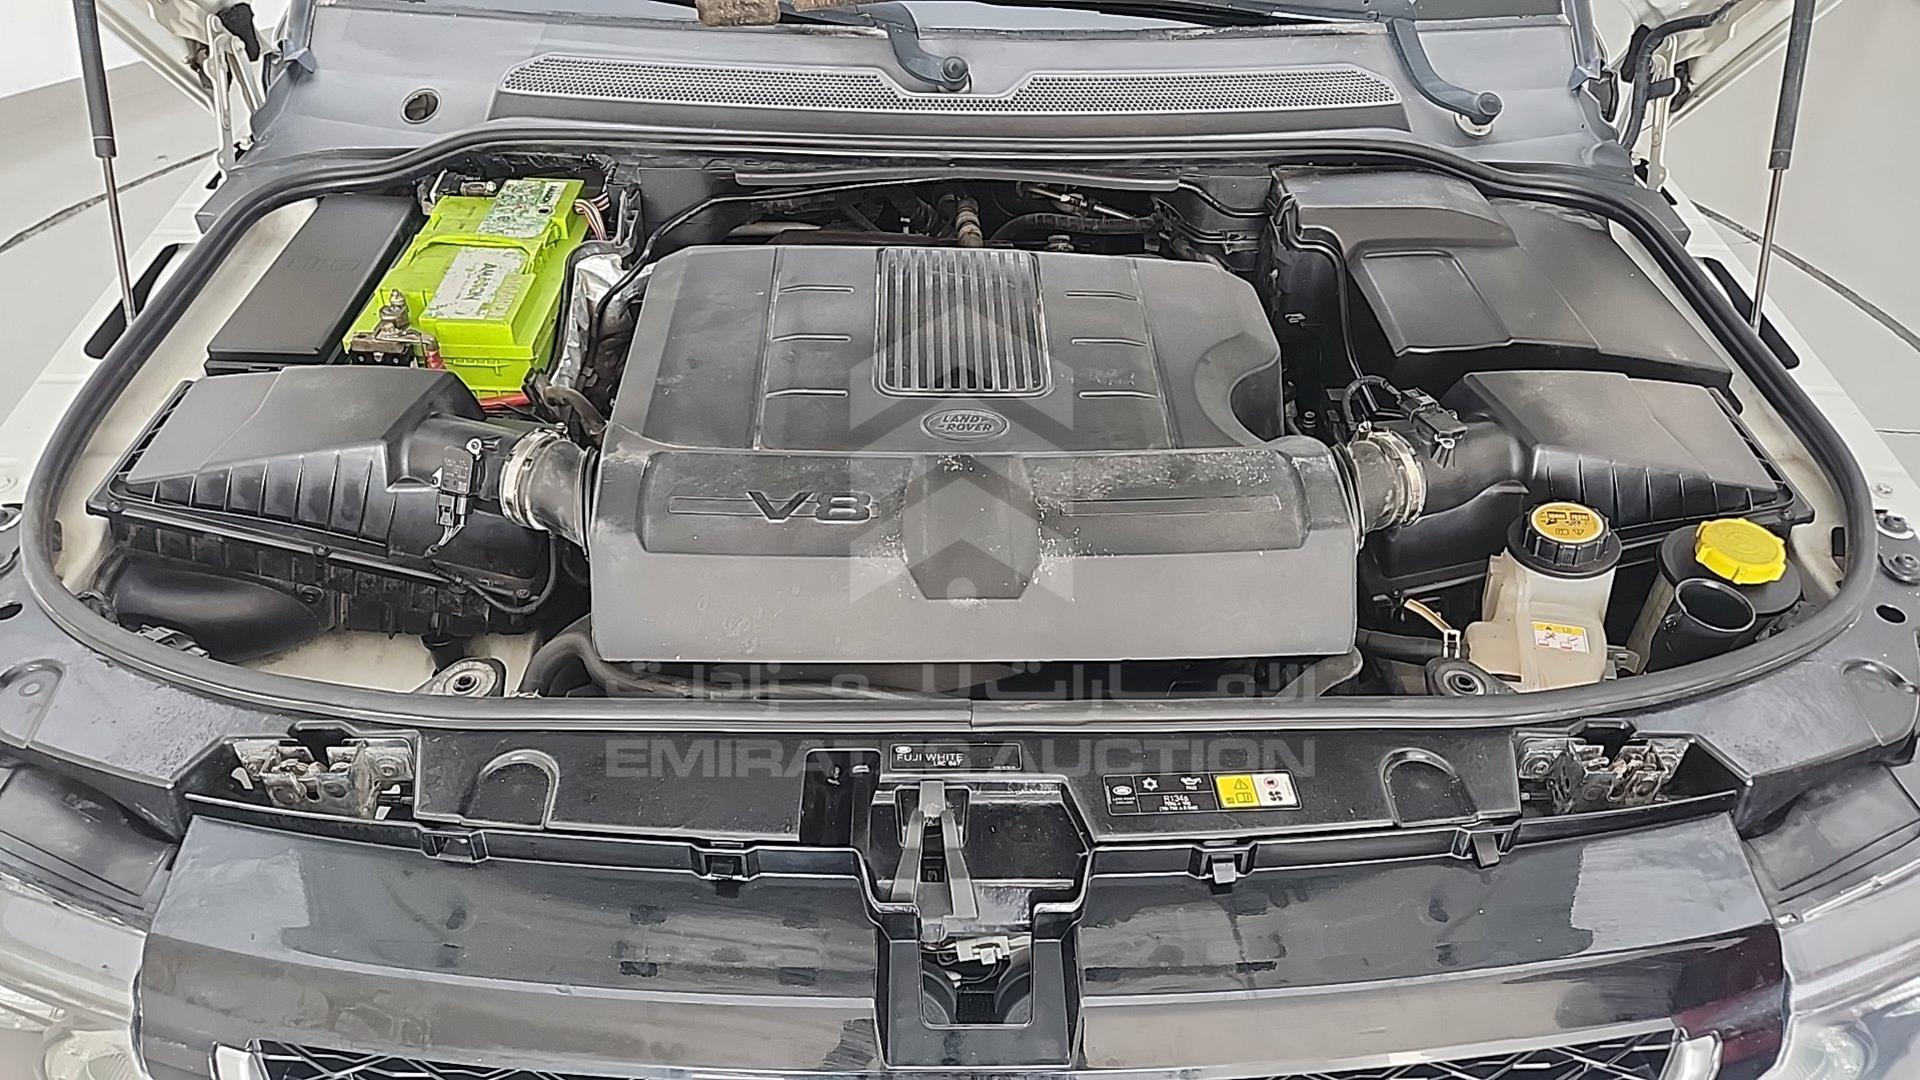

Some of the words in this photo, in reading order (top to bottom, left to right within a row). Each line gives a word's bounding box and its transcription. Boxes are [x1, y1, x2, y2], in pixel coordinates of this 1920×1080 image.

[942, 414, 980, 423] LAND
[945, 423, 992, 432] ROVER
[746, 490, 872, 524] V8
[896, 753, 922, 762] FUJI
[925, 753, 964, 762] WHITE
